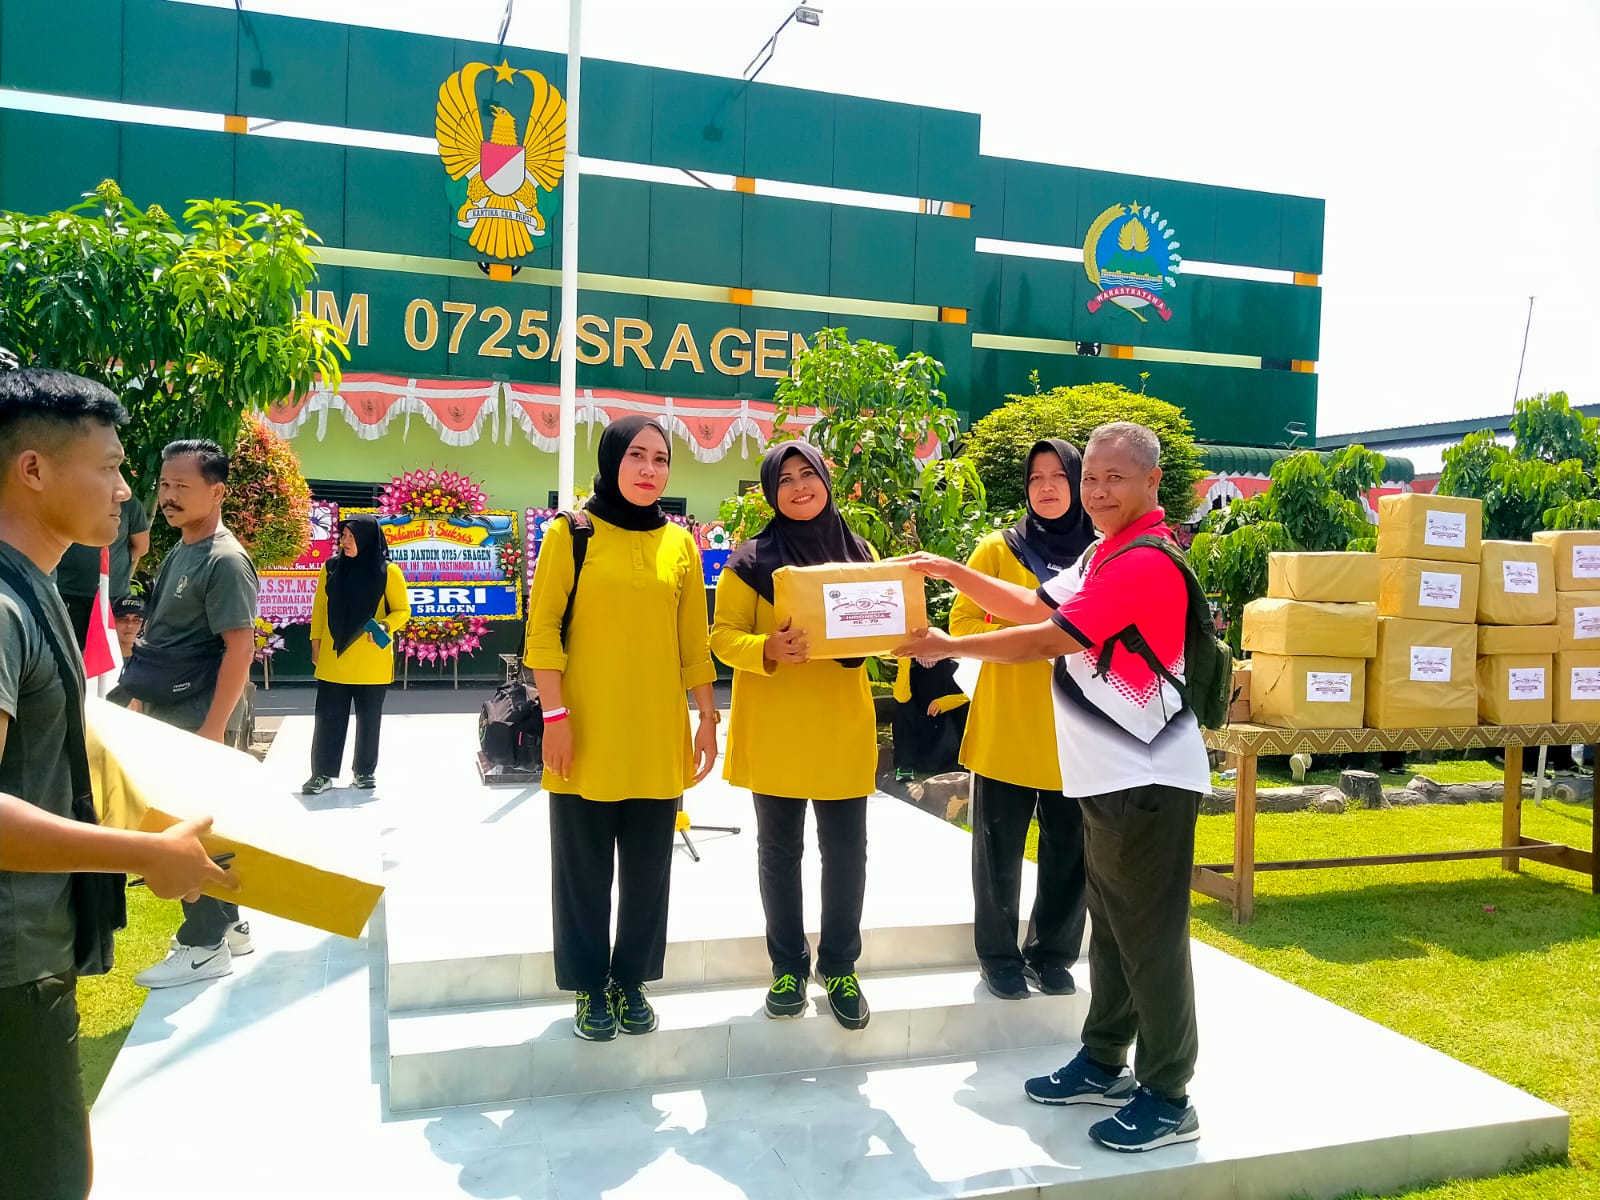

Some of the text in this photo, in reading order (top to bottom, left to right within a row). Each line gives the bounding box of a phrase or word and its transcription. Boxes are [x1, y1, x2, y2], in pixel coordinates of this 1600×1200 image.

[292, 290, 369, 347] IM
[385, 520, 427, 545] Selamat
[436, 521, 474, 545] Sukses
[410, 549, 440, 561] DANDIM
[407, 587, 487, 605] BRI
[260, 605, 299, 615] BESERTA
[416, 604, 476, 614] SRAGEN
